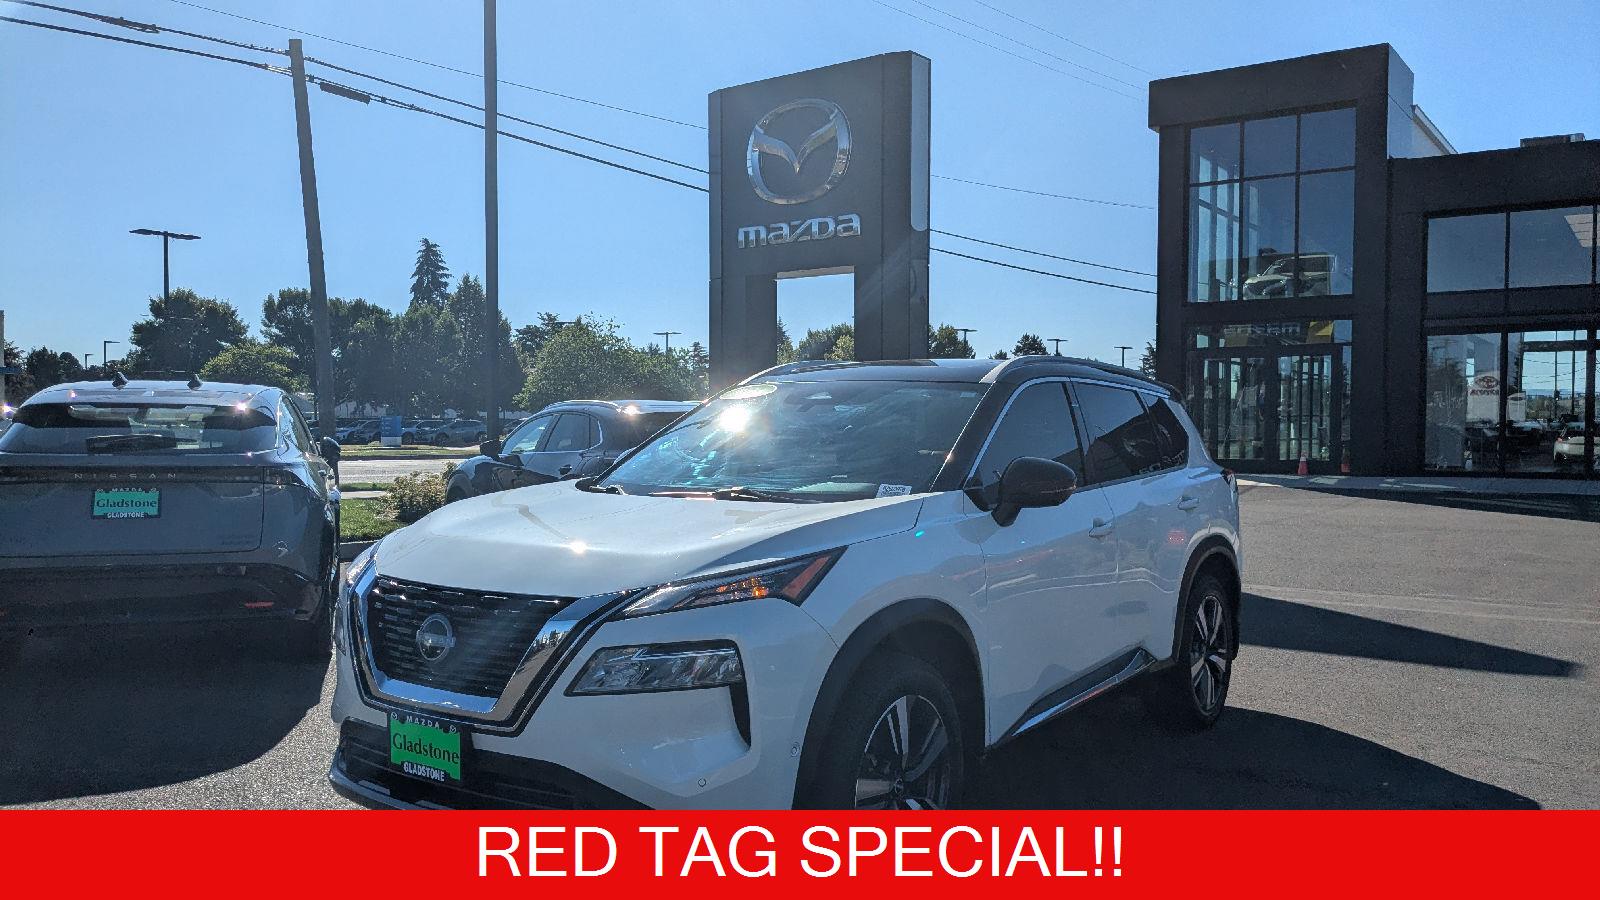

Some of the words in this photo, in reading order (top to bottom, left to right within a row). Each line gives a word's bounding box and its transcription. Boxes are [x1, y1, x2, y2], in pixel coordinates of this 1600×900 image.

[96, 499, 157, 508] Gladstone
[406, 715, 440, 729] MAZDA
[392, 732, 459, 764] Gladstone
[403, 761, 445, 782] GLADSTONE
